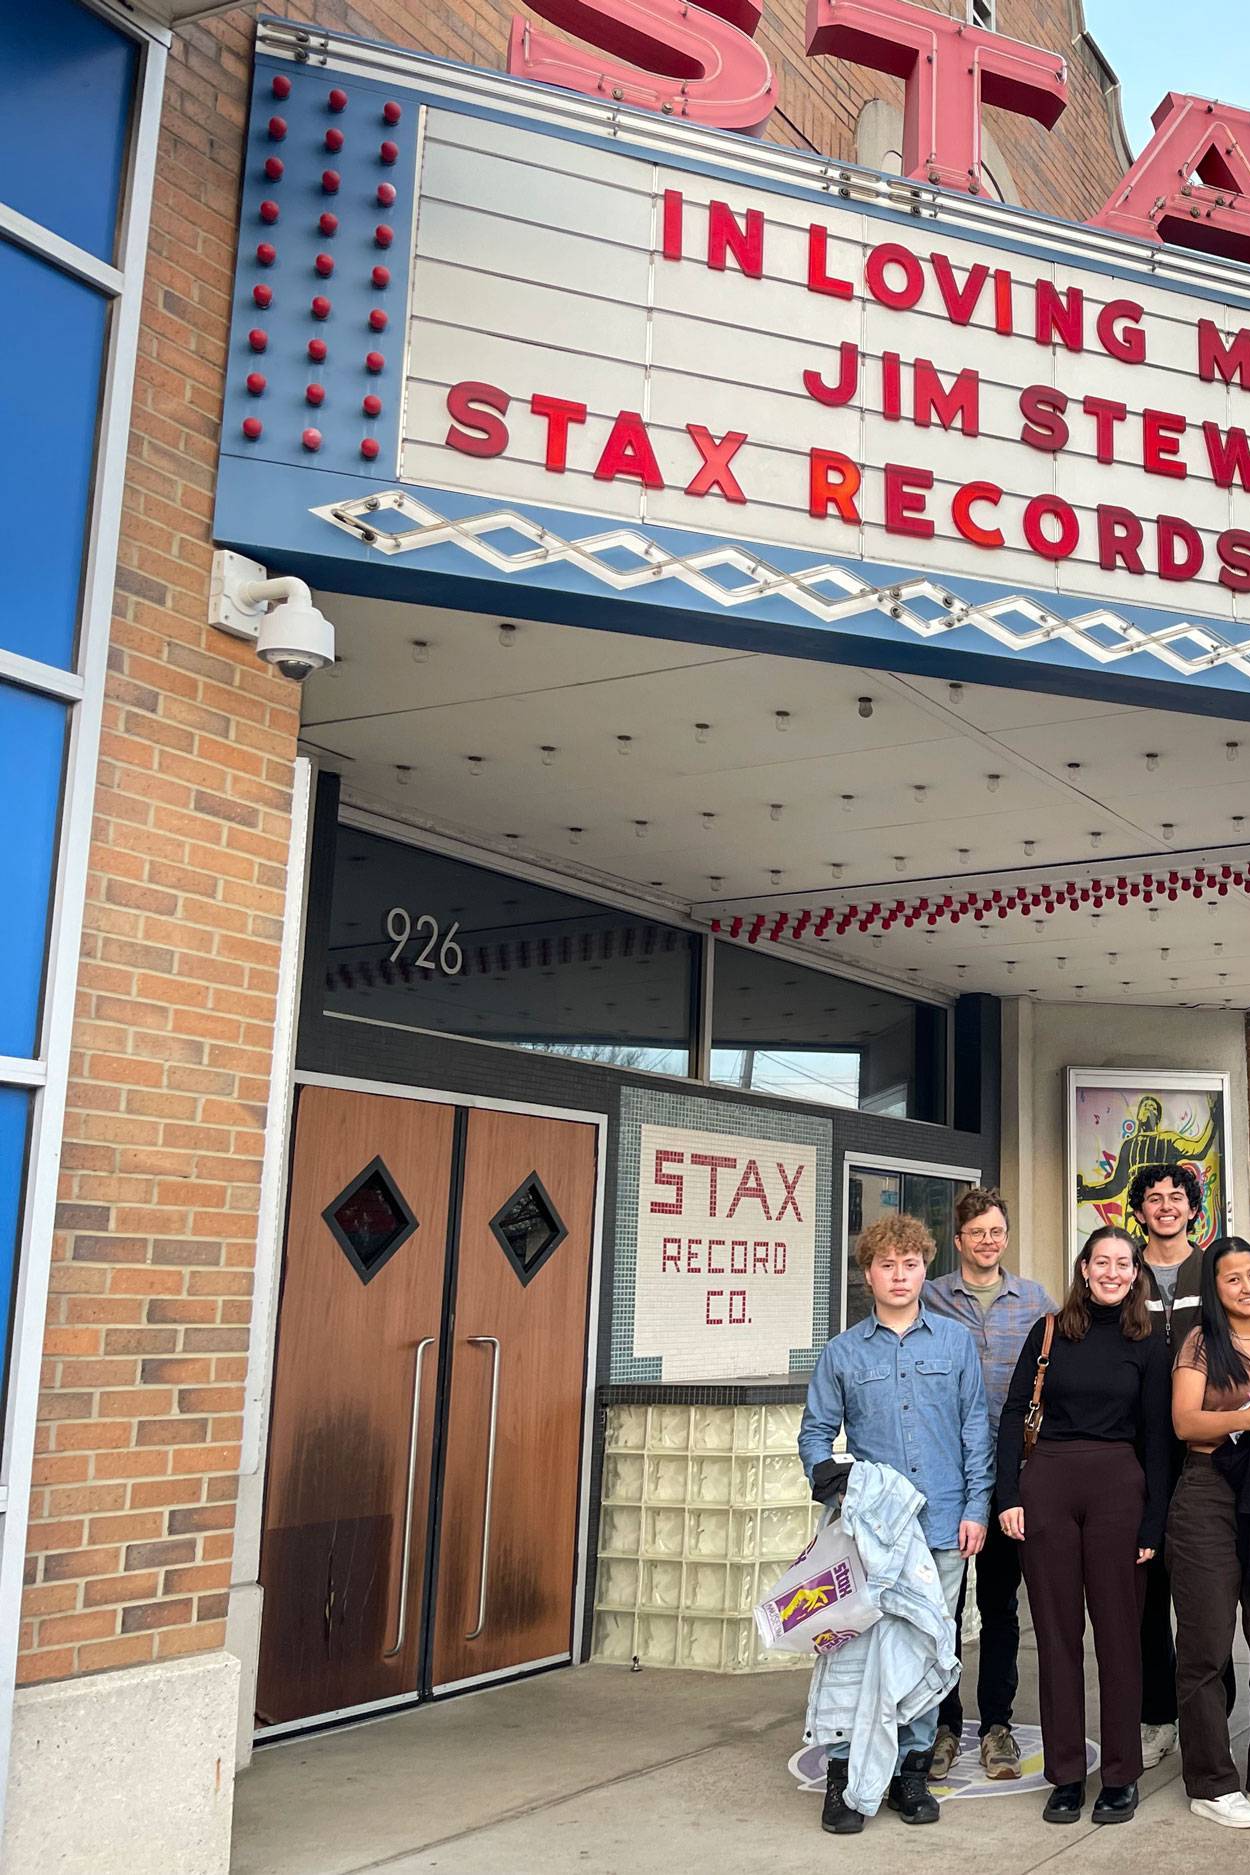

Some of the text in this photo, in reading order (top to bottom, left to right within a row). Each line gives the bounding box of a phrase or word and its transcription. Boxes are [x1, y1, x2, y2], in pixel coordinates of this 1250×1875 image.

[662, 189, 763, 280] IN
[808, 224, 1146, 364] LOVING
[803, 341, 979, 437] JIM
[445, 381, 748, 503] STAX
[387, 908, 463, 975] 926
[650, 1149, 804, 1222] STAX
[662, 1237, 786, 1274] RECORD
[706, 1290, 752, 1325] CO.
